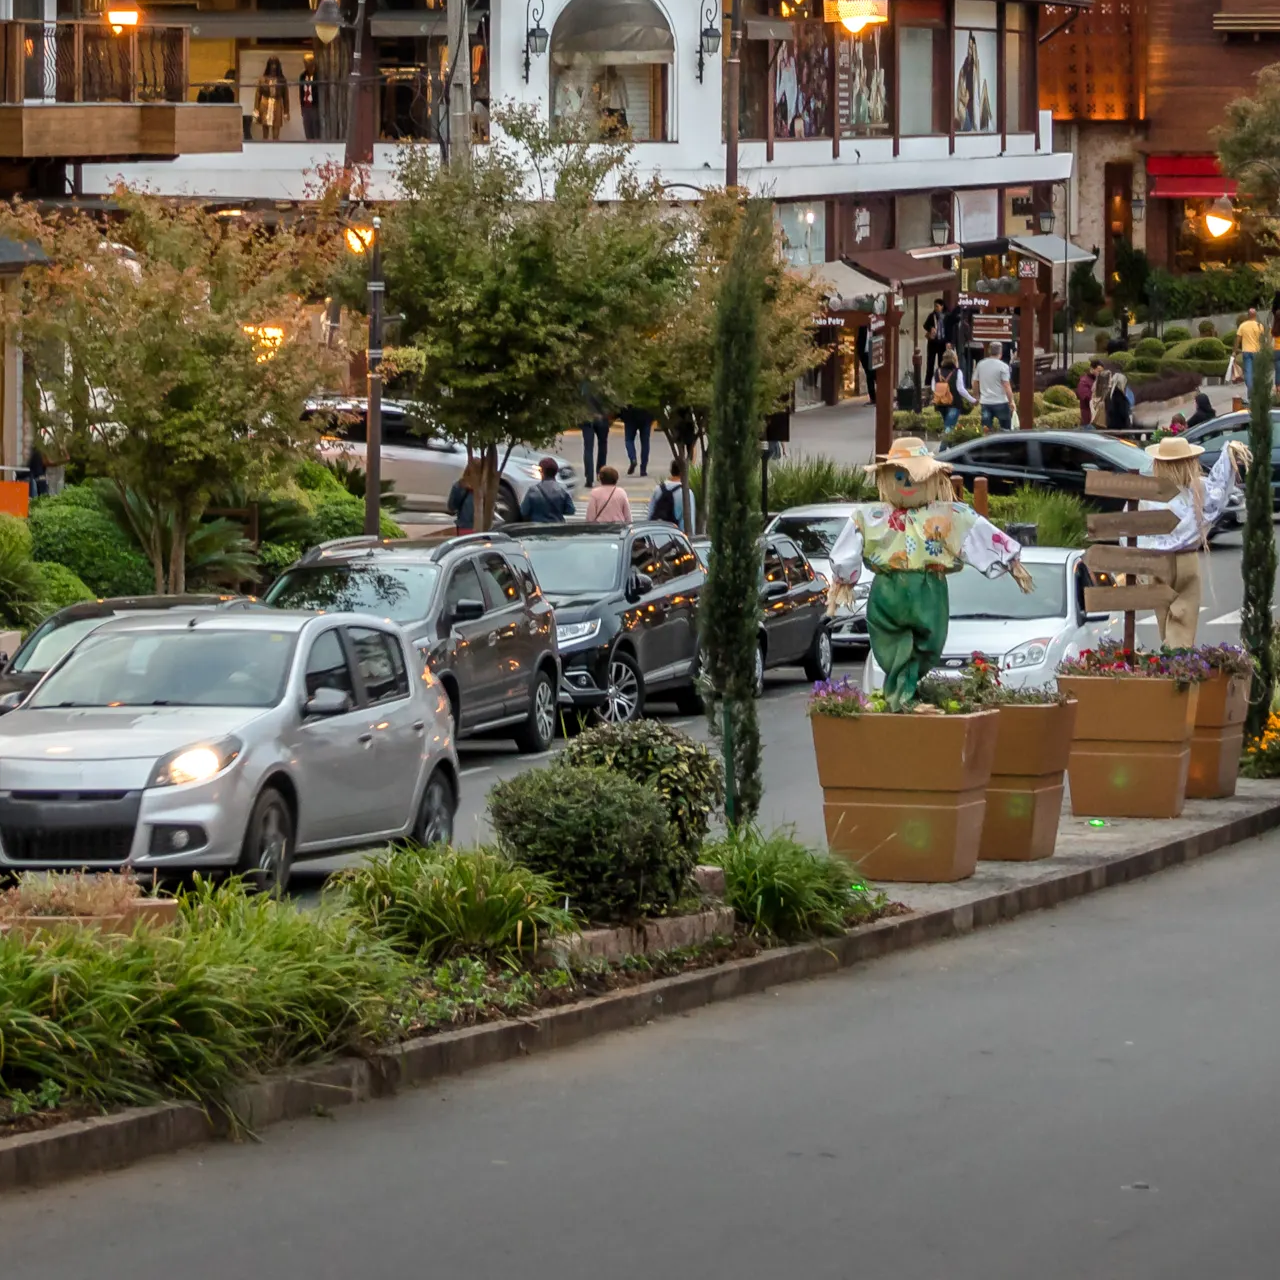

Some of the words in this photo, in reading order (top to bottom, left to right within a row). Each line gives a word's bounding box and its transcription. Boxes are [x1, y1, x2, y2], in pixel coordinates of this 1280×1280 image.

[957, 298, 973, 306] João
[973, 297, 990, 308] Petry
[827, 316, 846, 327] Petry
